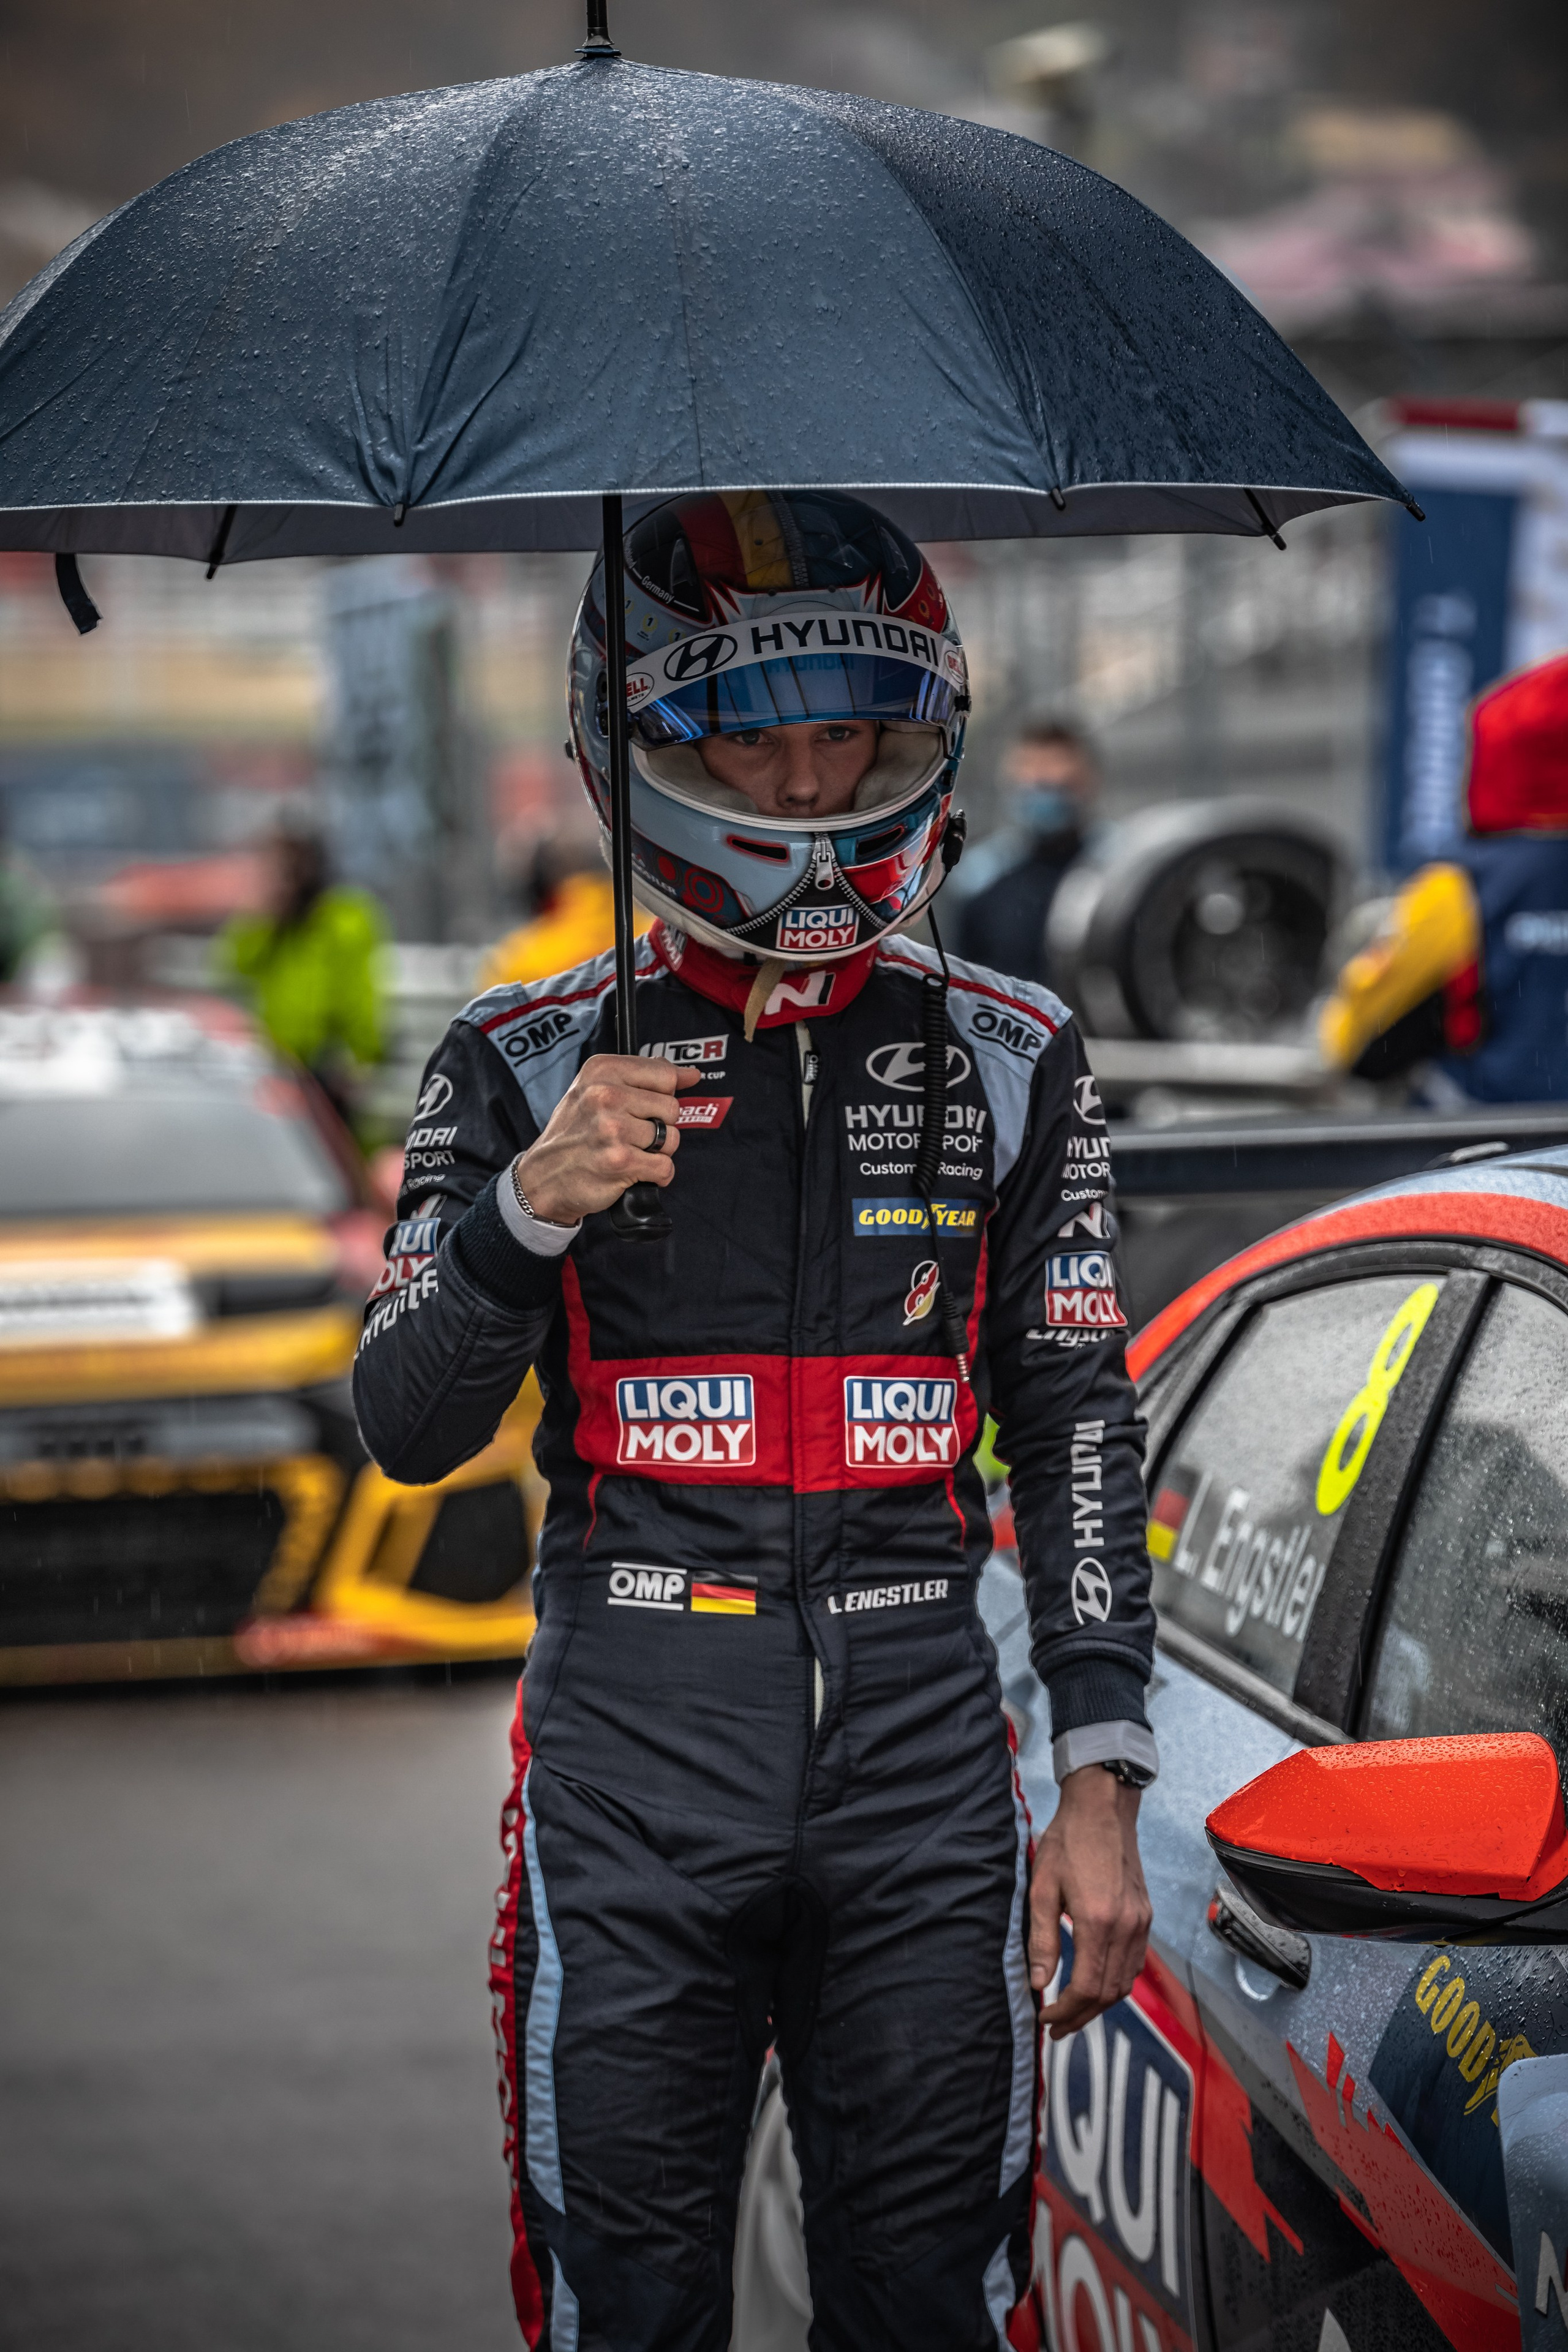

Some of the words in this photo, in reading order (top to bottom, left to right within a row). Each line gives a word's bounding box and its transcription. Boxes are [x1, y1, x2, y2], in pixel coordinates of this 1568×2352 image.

[642, 575, 674, 604] Germany
[751, 619, 939, 666] HYUNDAI
[626, 677, 648, 697] ELL
[785, 908, 854, 929] LIQUI
[783, 927, 854, 948] MOLY
[505, 1012, 572, 1057] OMP
[972, 1012, 1042, 1051] OMP
[707, 1071, 726, 1080] CUP
[845, 1104, 987, 1133] HYUDAI
[404, 1150, 455, 1170] SPORT
[860, 1162, 918, 1175] Custom
[1061, 1162, 1110, 1180] MOTOR
[859, 1204, 976, 1229] GOODYEAR
[376, 1257, 434, 1292] OLY
[1052, 1291, 1119, 1324] MOLY
[624, 1379, 746, 1421] LIQUI
[852, 1382, 952, 1423] LIQUI
[1315, 1282, 1439, 1517] 8
[625, 1423, 751, 1462] MOLY
[853, 1425, 954, 1464] MOLY
[609, 1569, 685, 1602] OMP
[845, 1578, 949, 1613] ENGSTLER
